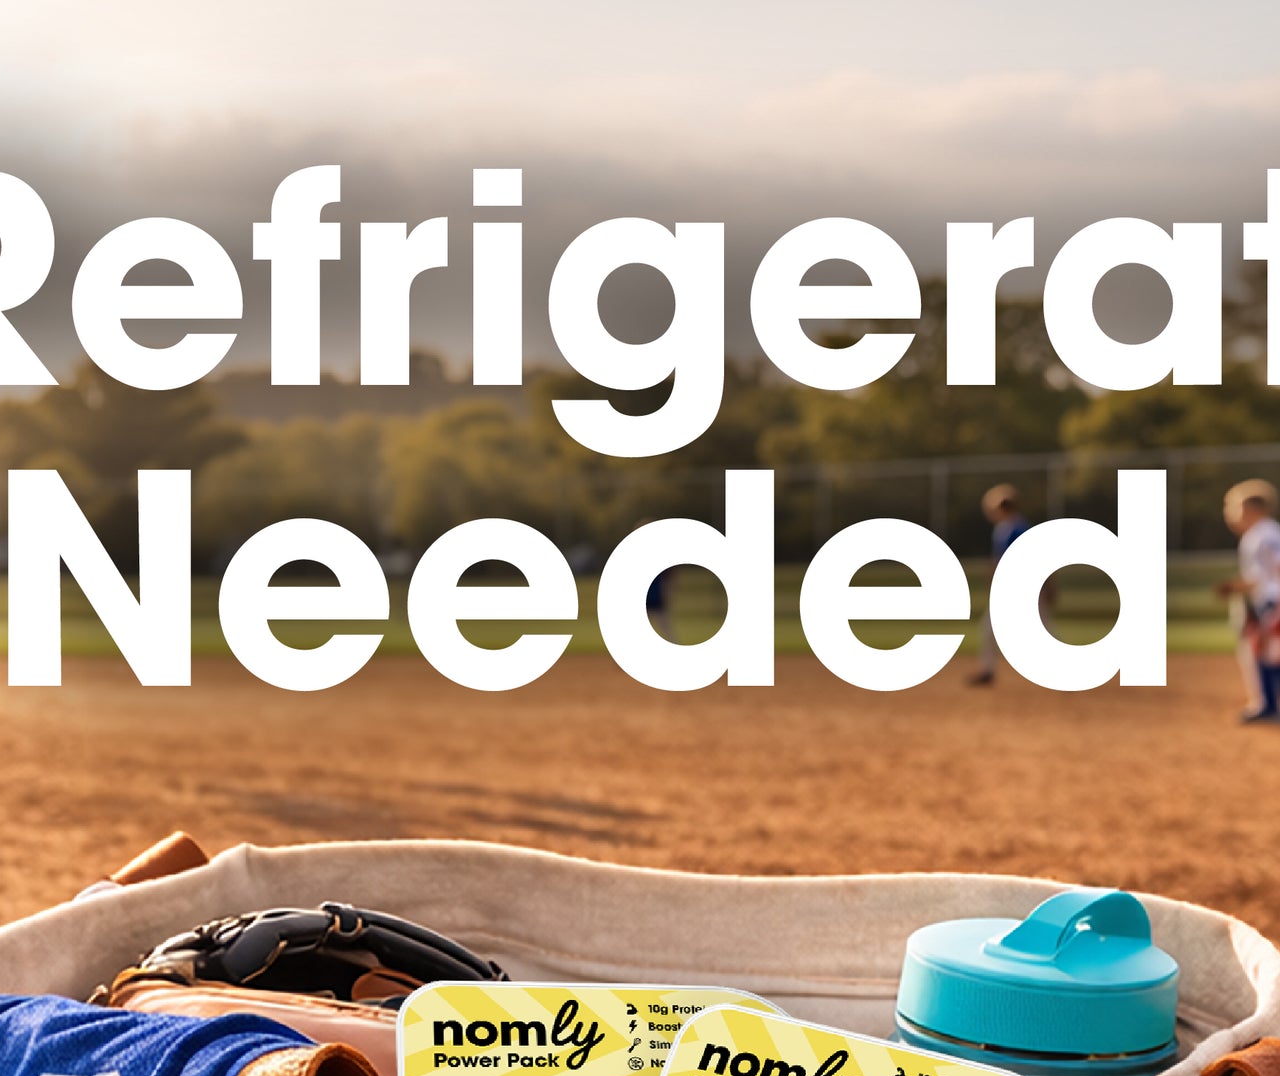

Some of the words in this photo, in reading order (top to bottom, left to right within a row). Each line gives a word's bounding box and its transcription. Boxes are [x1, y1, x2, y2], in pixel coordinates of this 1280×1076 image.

[648, 1004, 668, 1015] 10g
[672, 1004, 704, 1014] Prote
[648, 1021, 682, 1031] Boost
[433, 999, 606, 1070] nomly
[649, 1040, 672, 1049] Sim
[434, 1053, 501, 1068] Power
[508, 1053, 560, 1068] Pack
